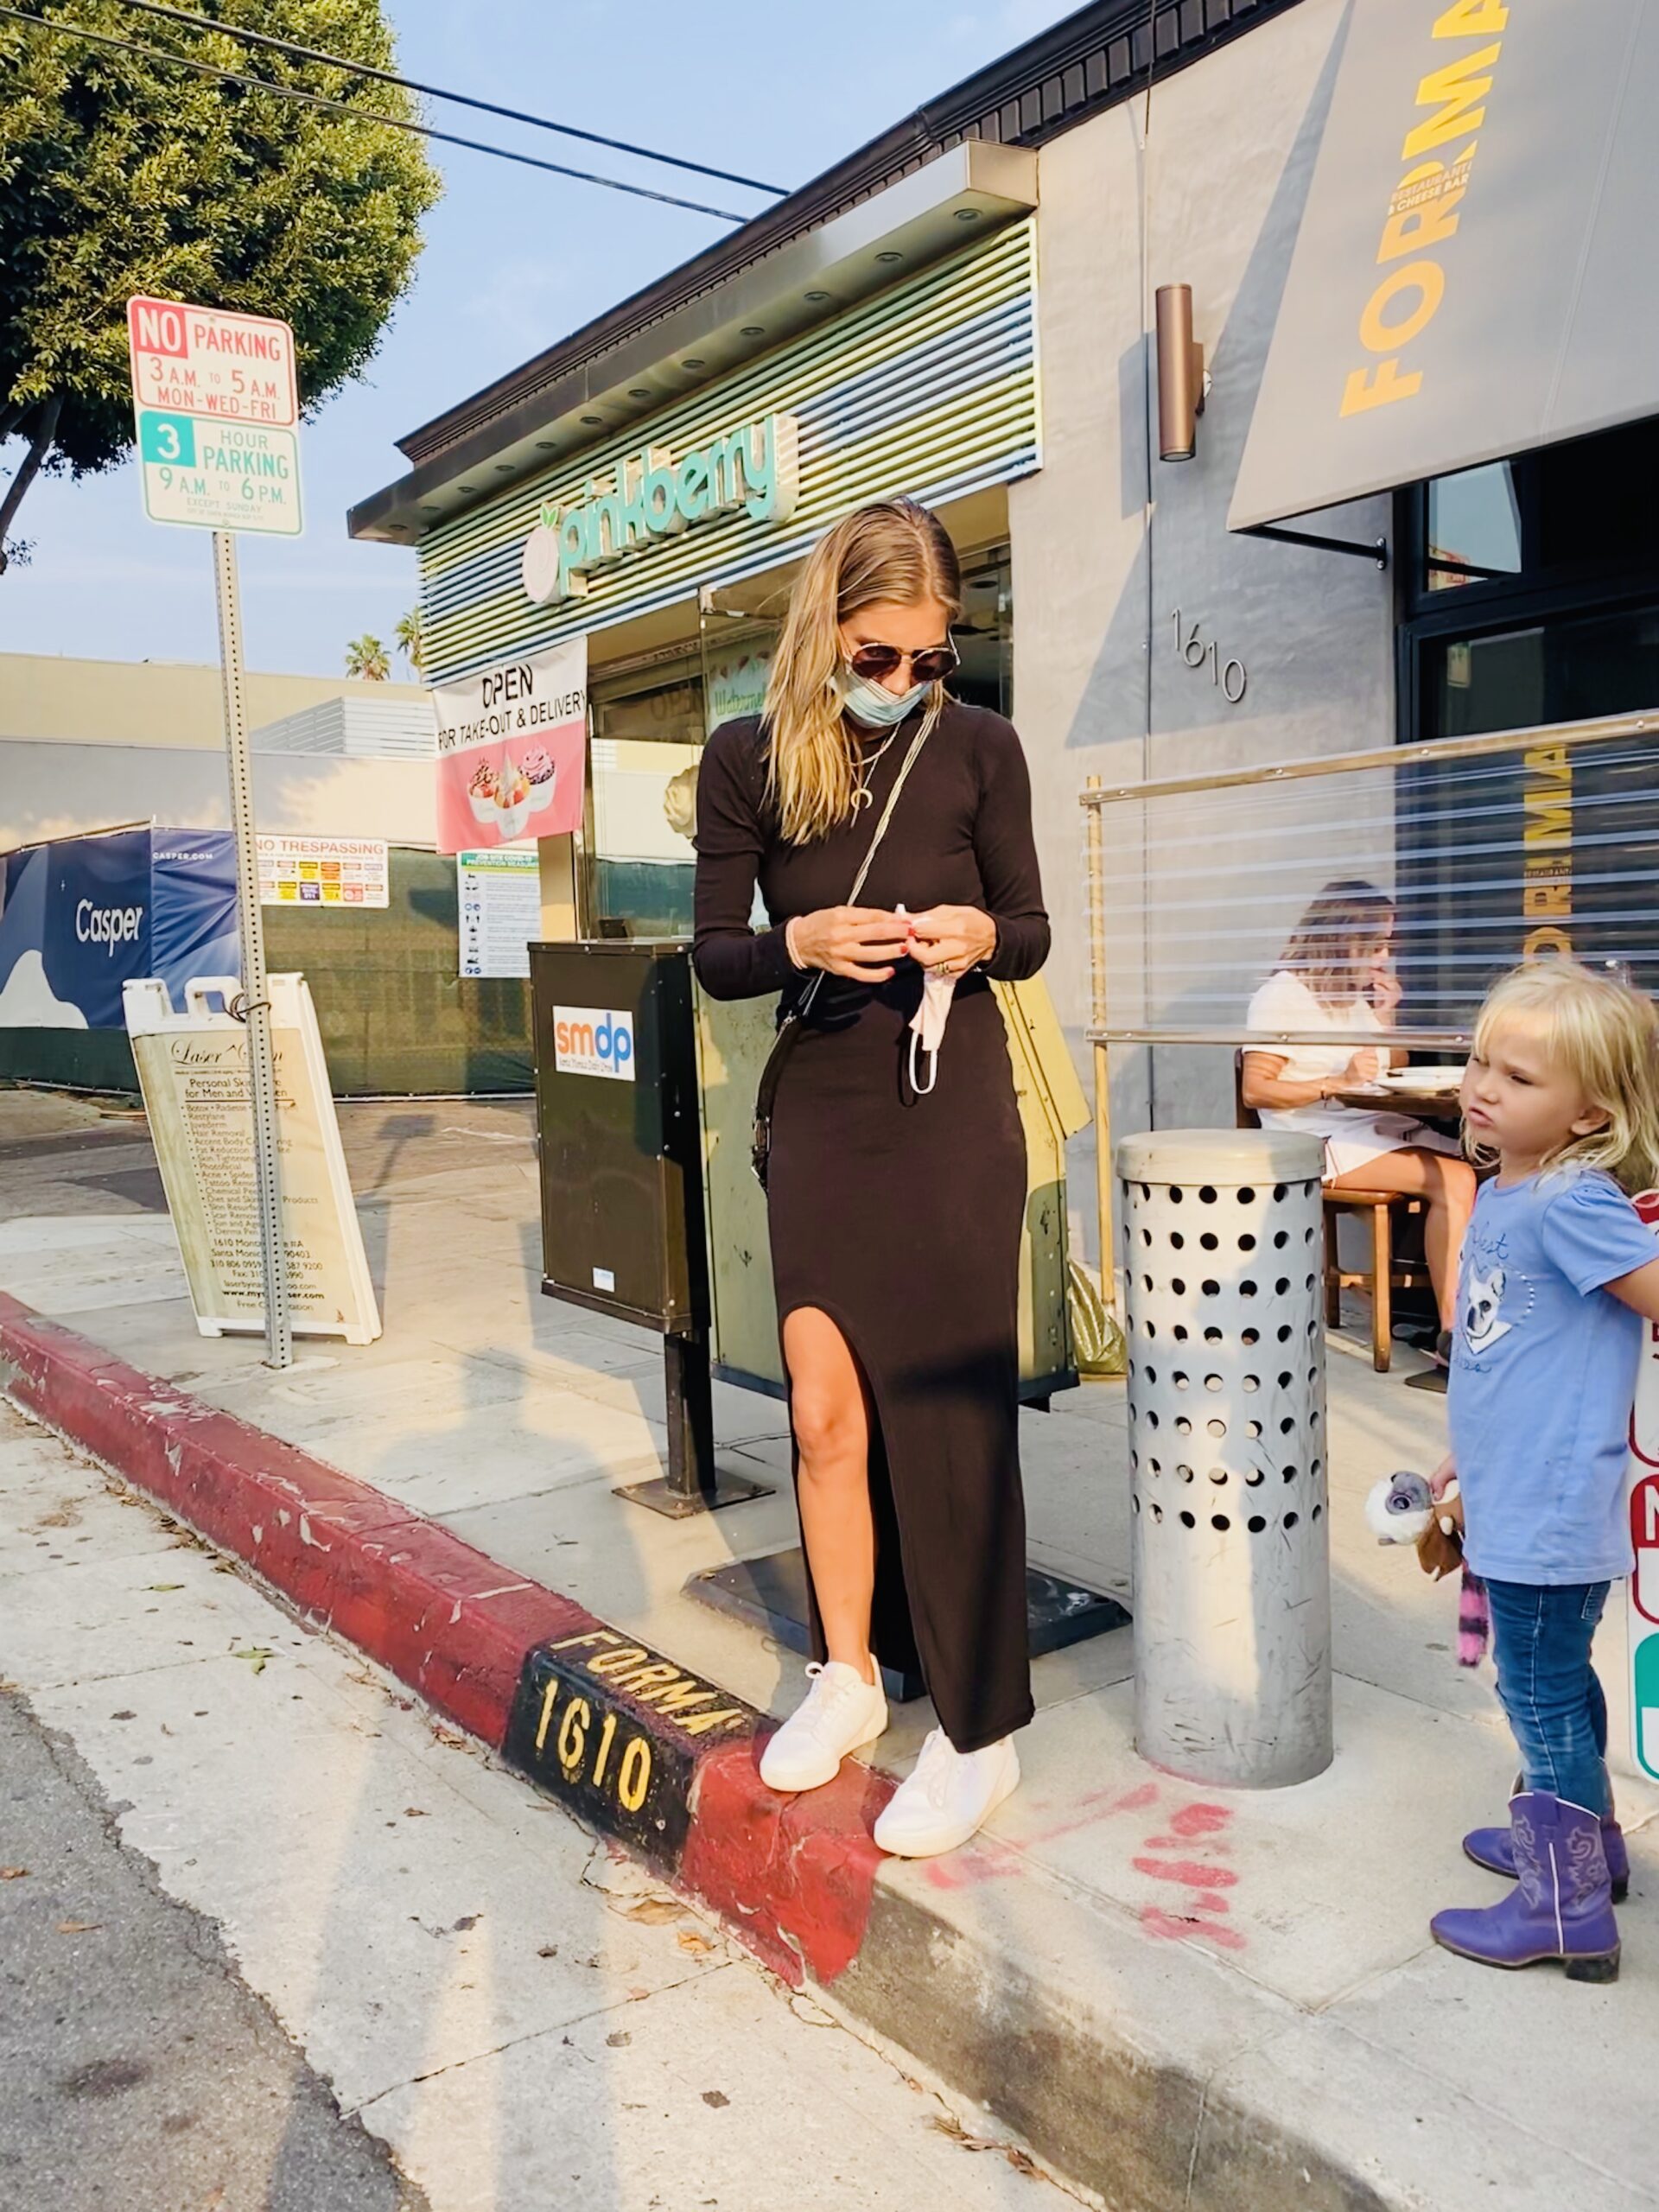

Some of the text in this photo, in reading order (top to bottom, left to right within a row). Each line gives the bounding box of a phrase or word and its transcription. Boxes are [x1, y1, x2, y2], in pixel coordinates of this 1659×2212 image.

[1339, 0, 1510, 418] FORMA
[137, 306, 281, 362] NO PARKING
[149, 356, 281, 401] 3 A.M. TO 5 A.M.
[157, 386, 276, 420] MON-WED-FRI
[157, 423, 269, 460] 3 HOUR
[203, 446, 289, 480] PARKING
[159, 467, 287, 505] 9 A.M. TO 6 P.M.
[187, 497, 262, 512] EXCEPT SUNDAY
[559, 413, 777, 598] pinkberry
[1172, 607, 1247, 703] 1610
[482, 664, 533, 709] OPEN
[437, 728, 456, 751] FOR
[460, 710, 512, 745] TAKE-OUT
[517, 708, 526, 728] &
[152, 851, 214, 861] CASPER.COM
[255, 839, 384, 855] NO TRESPASSING
[1523, 742, 1573, 963] ORMA
[75, 899, 143, 957] Casper
[171, 1039, 222, 1065] Laser
[556, 1013, 632, 1073] smdp
[185, 1089, 199, 1098] for
[202, 1089, 224, 1097] Men
[226, 1089, 245, 1097] and
[190, 1078, 231, 1089] Personal
[224, 1137, 244, 1147] Body
[213, 1238, 233, 1247] 1610
[550, 1630, 745, 1736] FORMA
[535, 1677, 652, 1812] 1610
